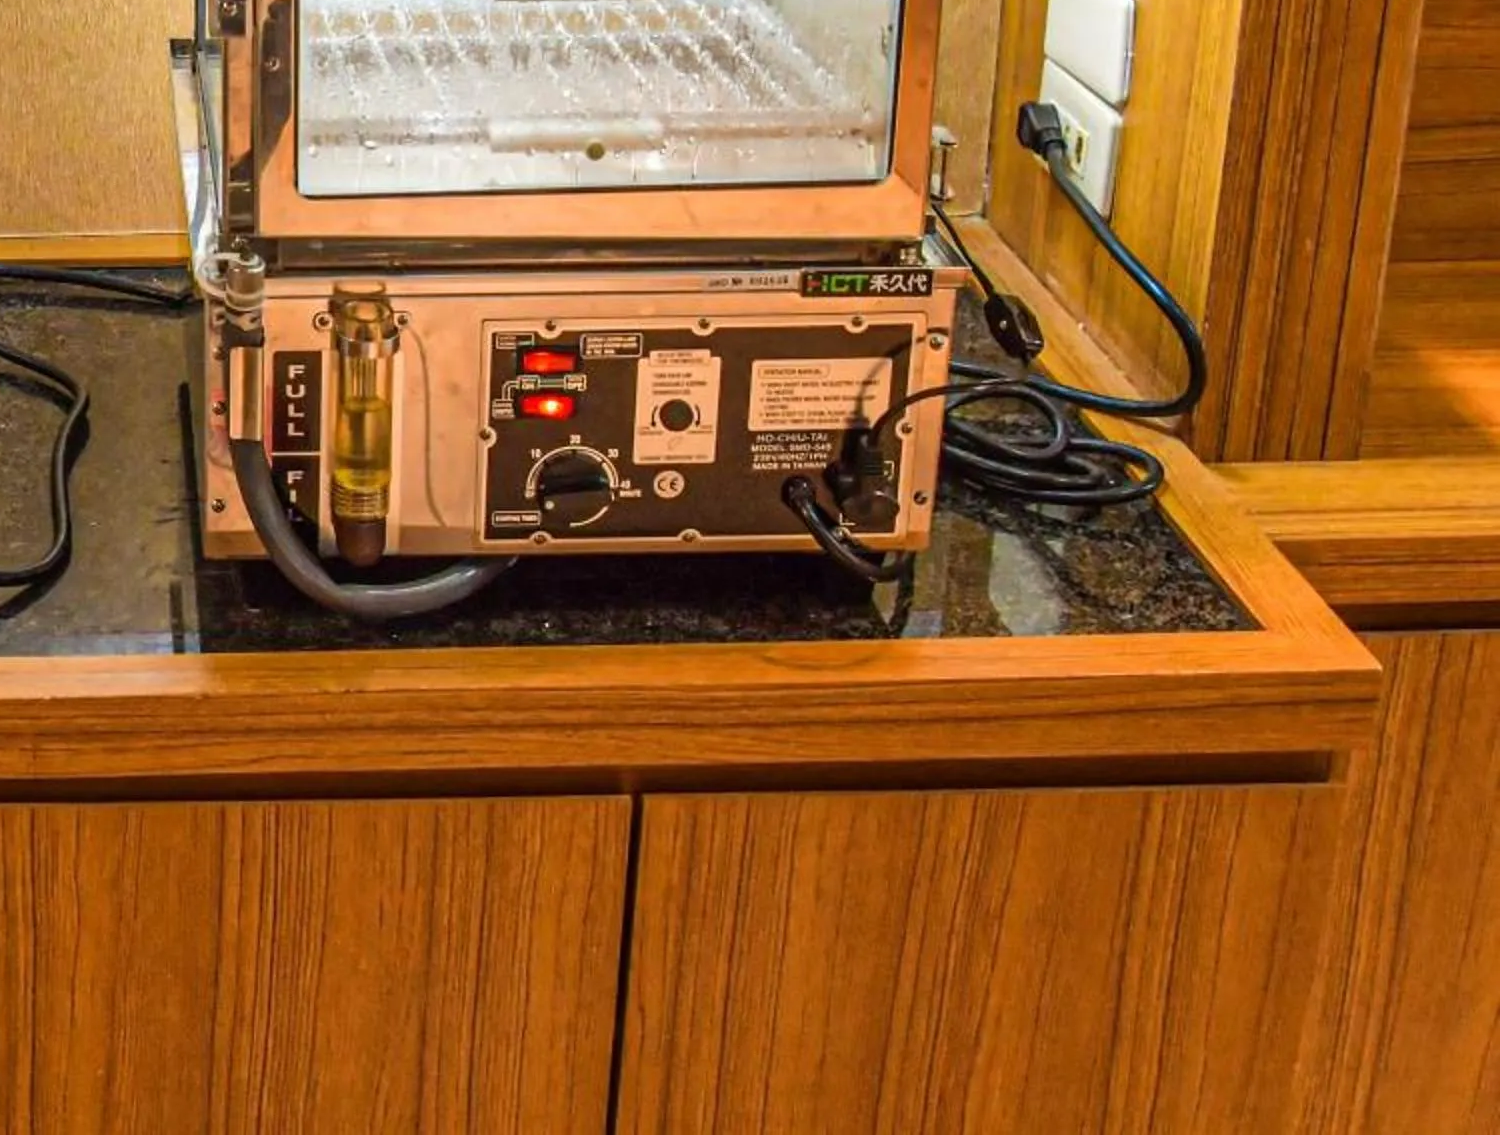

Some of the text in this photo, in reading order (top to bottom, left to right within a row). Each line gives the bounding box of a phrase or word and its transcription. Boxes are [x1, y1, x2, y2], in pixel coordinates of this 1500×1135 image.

[869, 273, 928, 293] 禾久代
[285, 365, 306, 436] FULL
